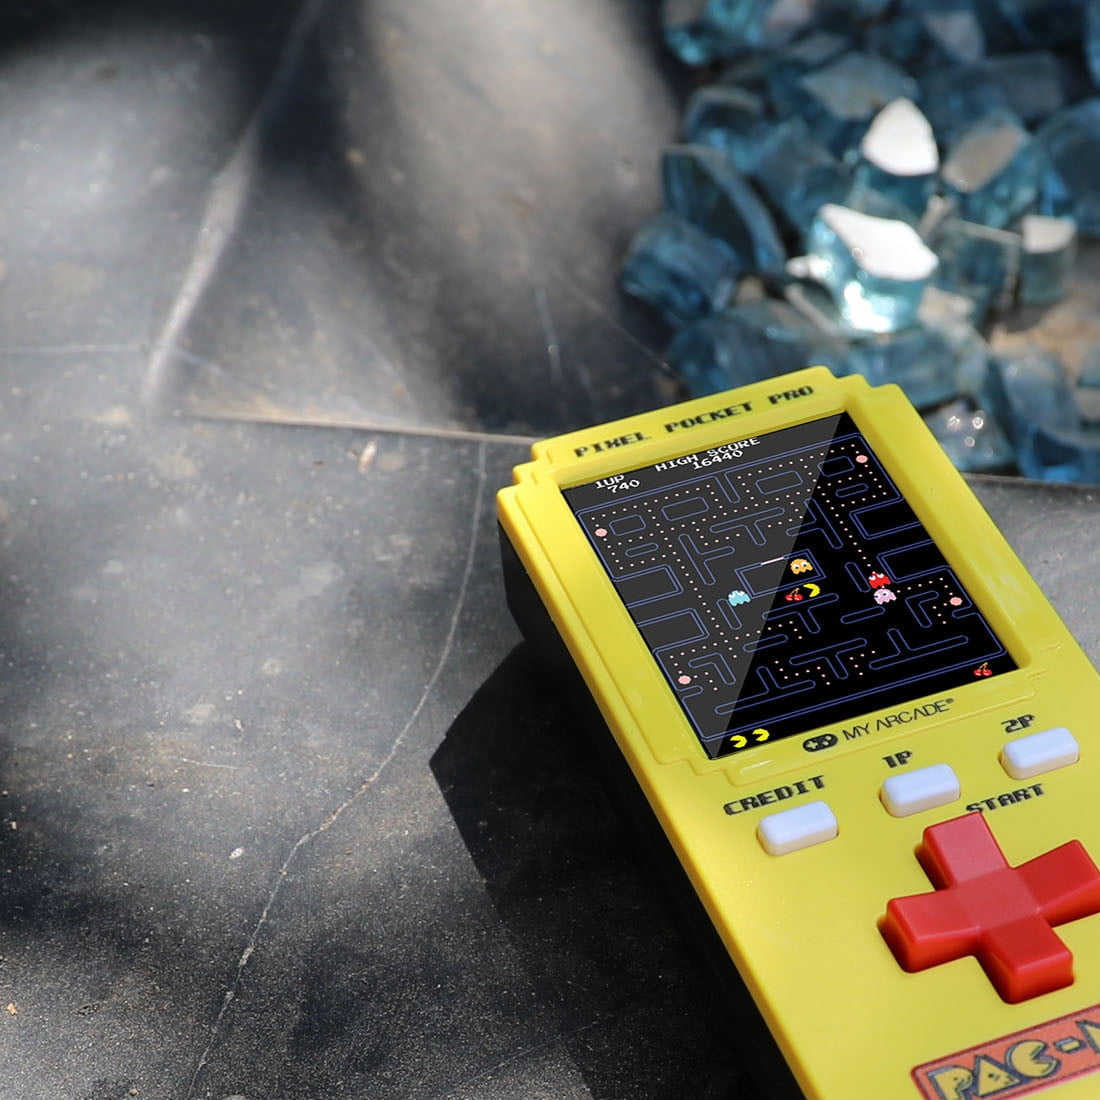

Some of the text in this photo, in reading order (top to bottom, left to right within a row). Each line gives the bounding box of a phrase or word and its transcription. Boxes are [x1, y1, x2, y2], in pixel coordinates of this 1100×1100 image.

[573, 385, 814, 458] PIXEL POCKET PRO
[654, 437, 760, 472] HIGH SCORE
[692, 449, 743, 470] 16440
[595, 474, 625, 490] 1UP
[609, 478, 641, 494] 740
[842, 722, 870, 741] MY
[1001, 714, 1035, 734] 2P
[882, 750, 913, 769] 1P
[723, 774, 825, 816] CREDIT
[966, 783, 1044, 812] START
